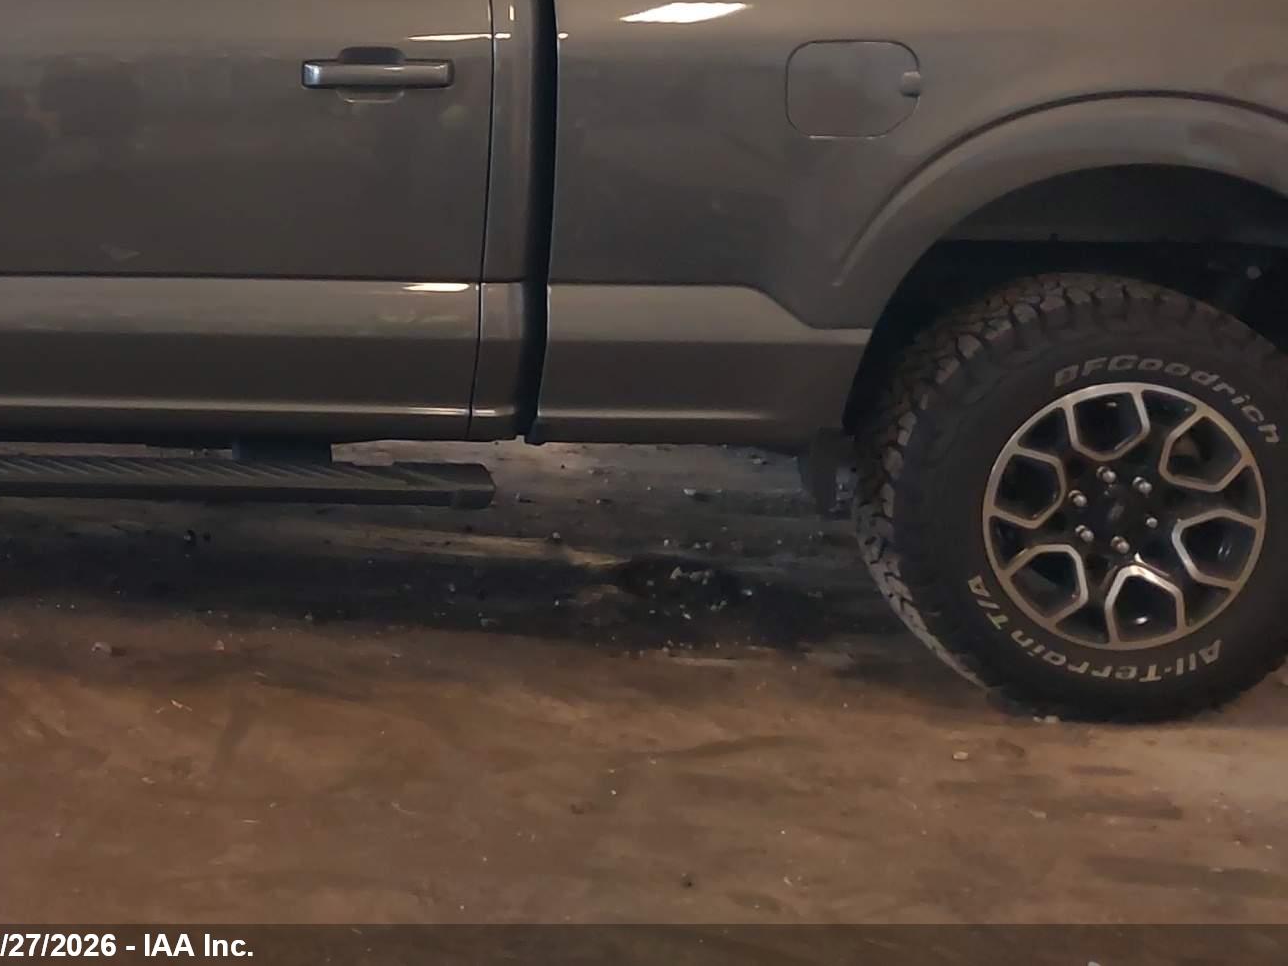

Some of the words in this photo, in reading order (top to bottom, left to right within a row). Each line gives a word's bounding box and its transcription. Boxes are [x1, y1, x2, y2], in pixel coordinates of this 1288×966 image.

[1054, 355, 1280, 443] BFGoodrich
[968, 575, 1008, 630] T/A
[1011, 630, 1222, 683] All-Terrain
